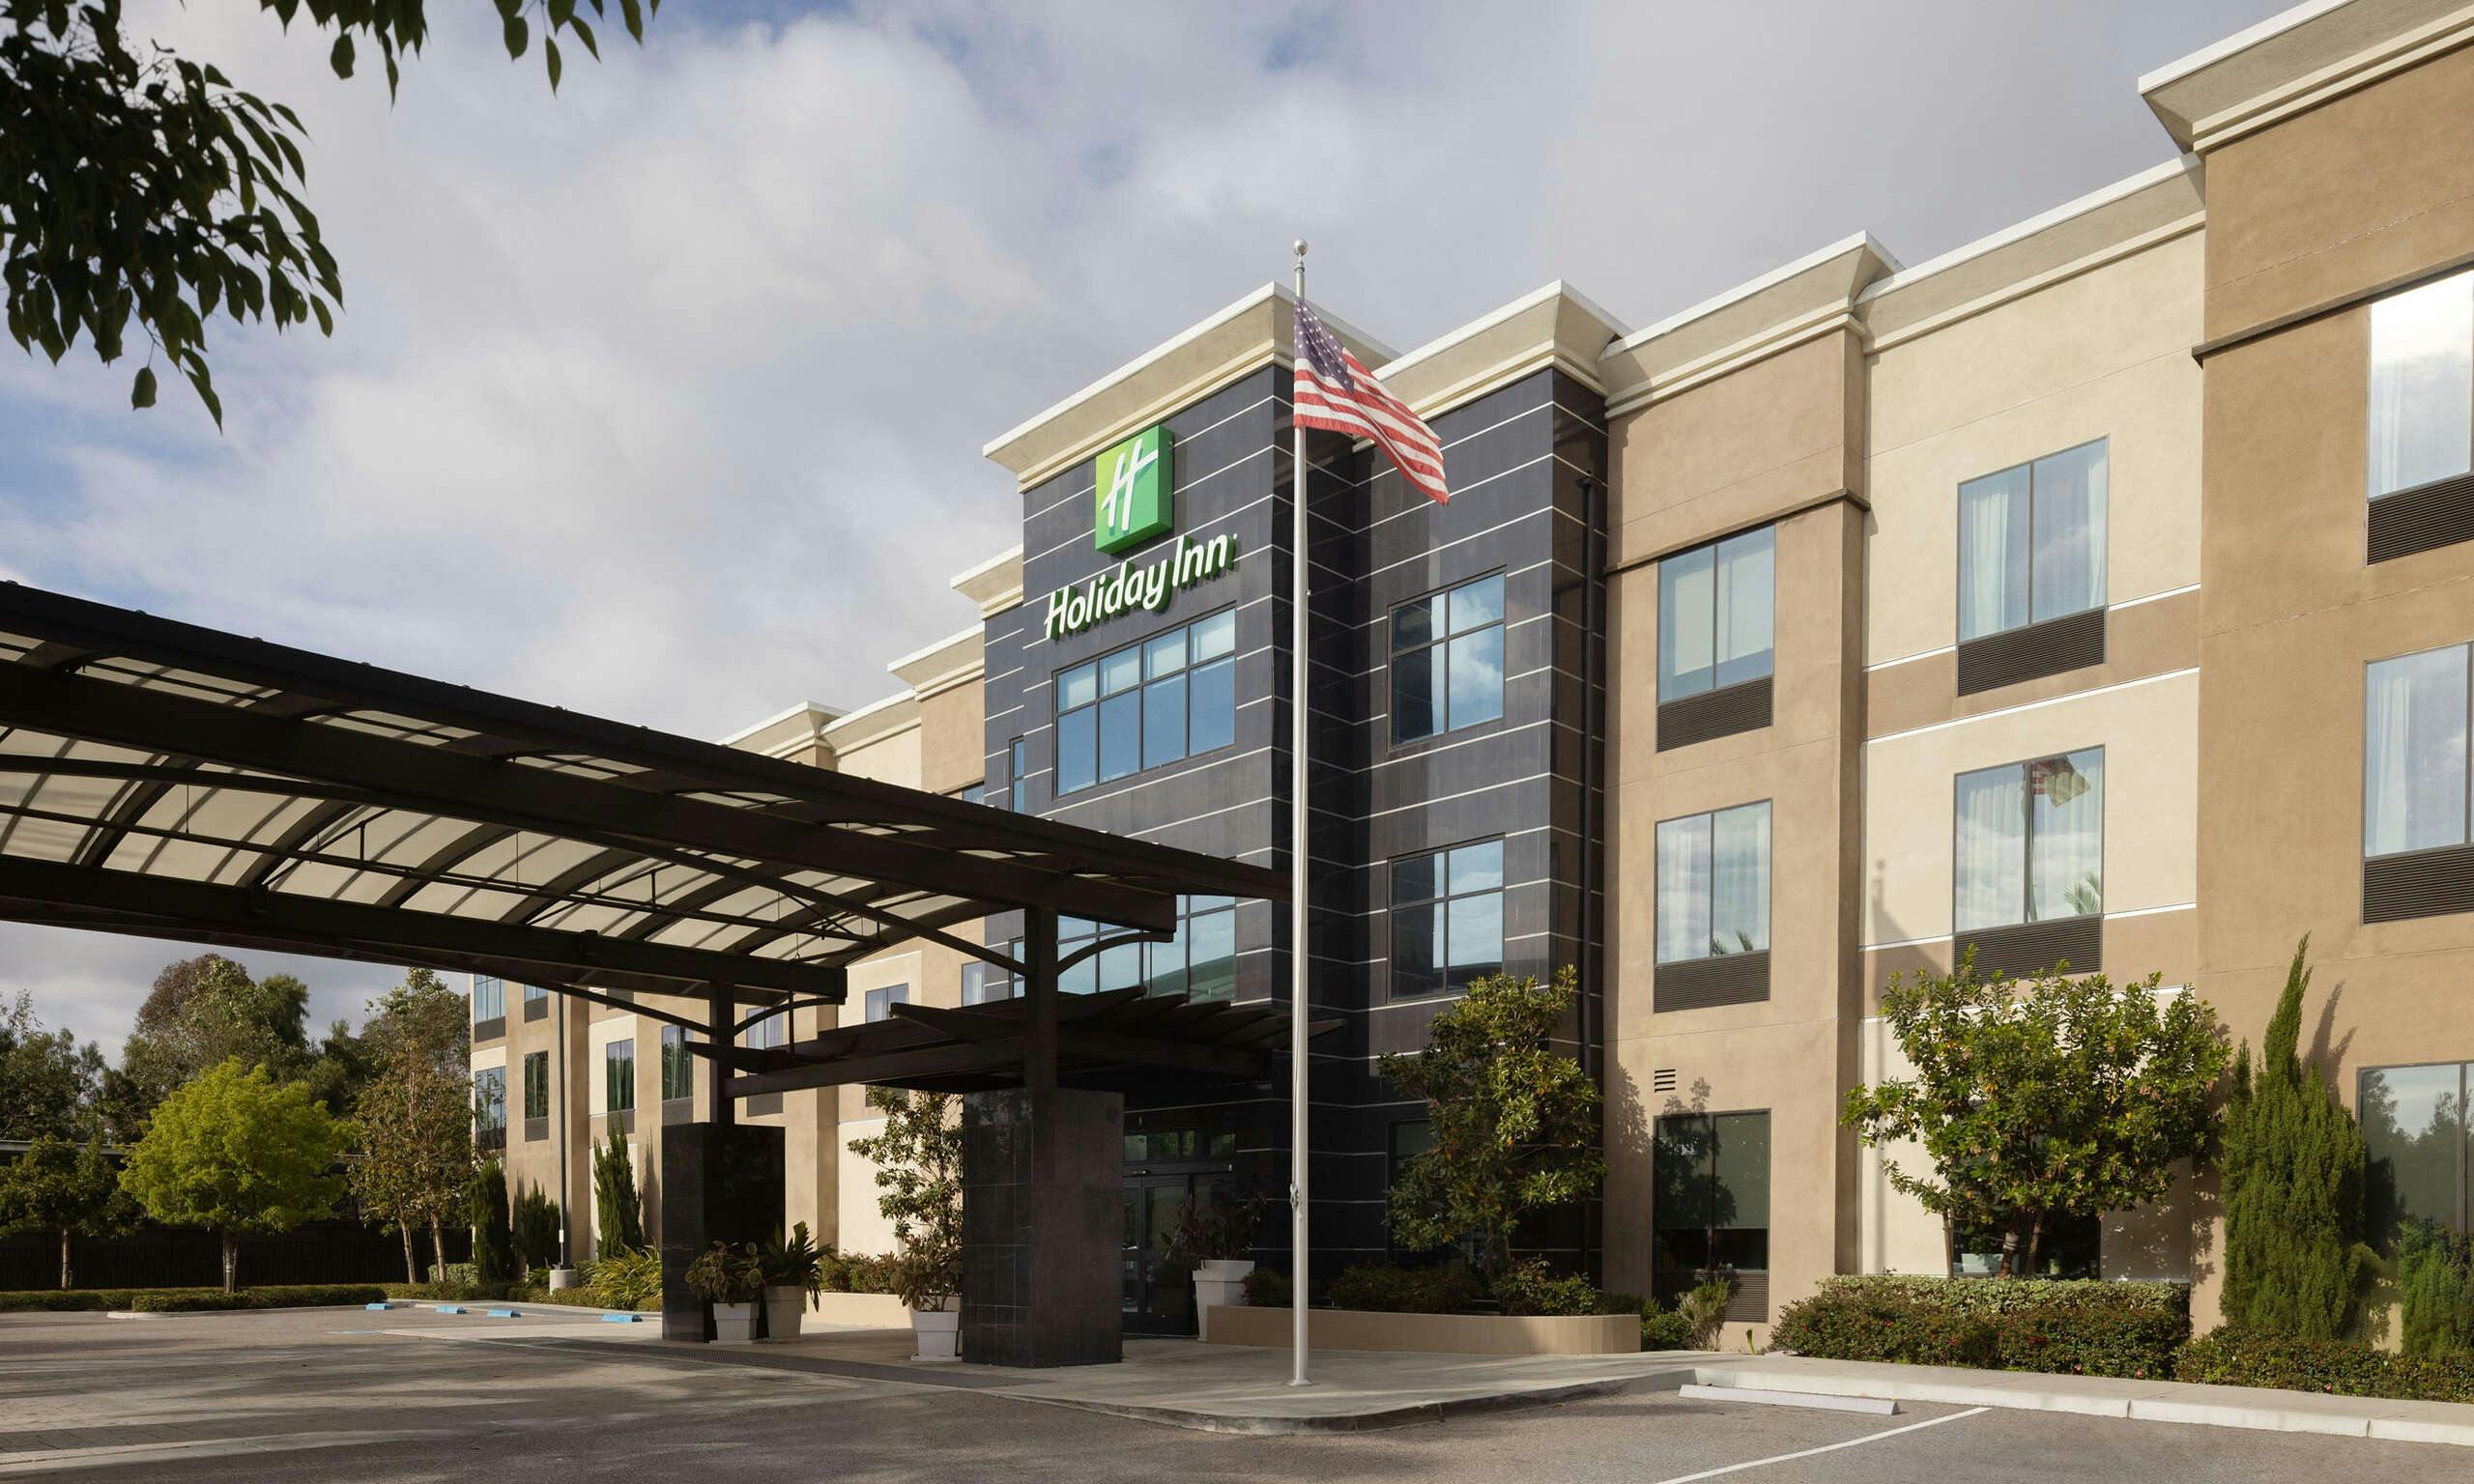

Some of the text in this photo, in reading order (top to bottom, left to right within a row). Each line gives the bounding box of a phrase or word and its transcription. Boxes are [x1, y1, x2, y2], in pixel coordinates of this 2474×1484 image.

[1100, 438, 1160, 531] H
[1044, 533, 1228, 640] Holiday Inn
